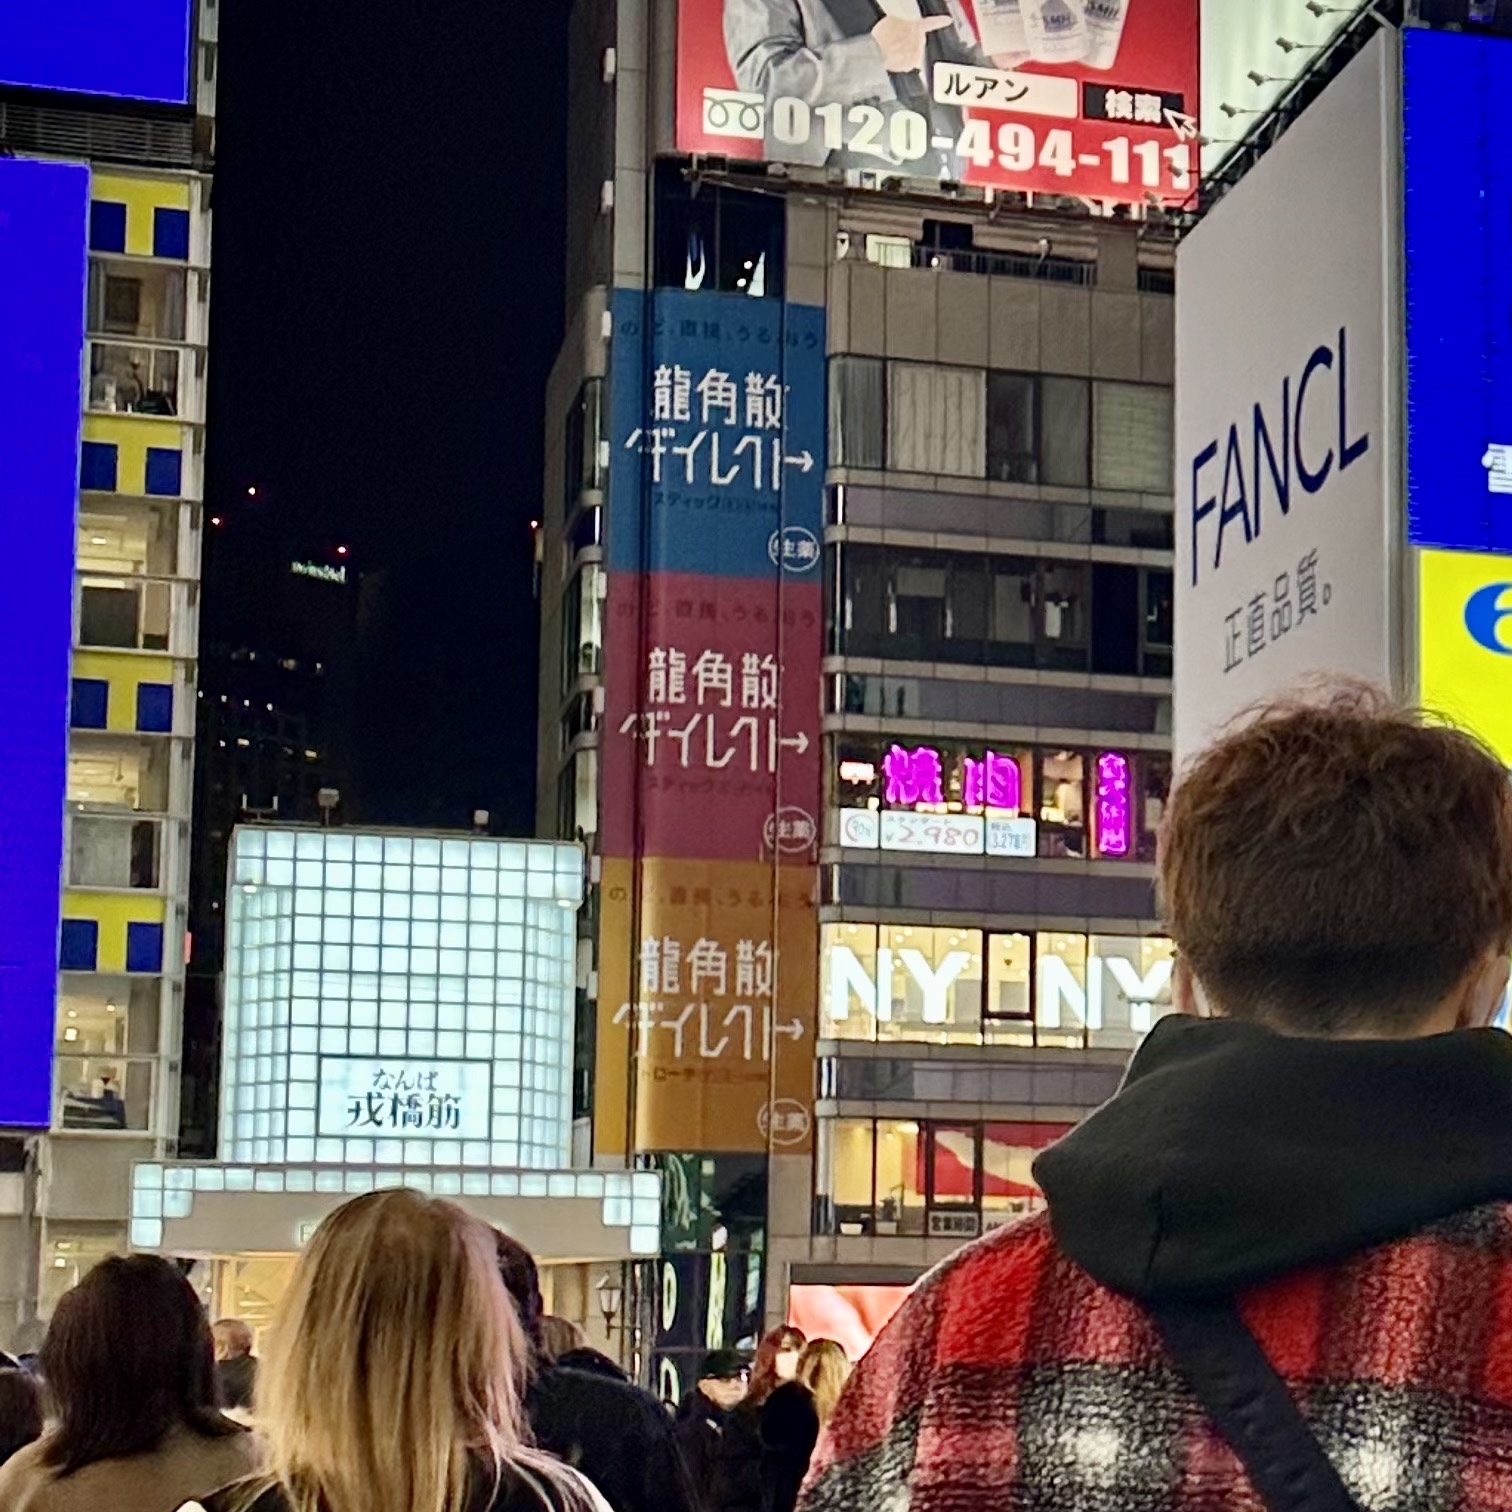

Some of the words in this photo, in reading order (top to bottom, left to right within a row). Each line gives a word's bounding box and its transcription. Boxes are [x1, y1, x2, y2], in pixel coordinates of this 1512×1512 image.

[944, 72, 1030, 103] ルアン
[772, 96, 1193, 190] 0120-494-111
[651, 363, 790, 430] 龍角散
[1191, 326, 1369, 588] FANCL
[1224, 547, 1332, 674] 正直品質。
[648, 647, 785, 709] 龍角散
[638, 935, 779, 997] 龍角散
[829, 946, 971, 1024] NY
[1036, 954, 1174, 1032] NY
[346, 1091, 461, 1130] 戎橋筋
[372, 1068, 439, 1091] なんば
